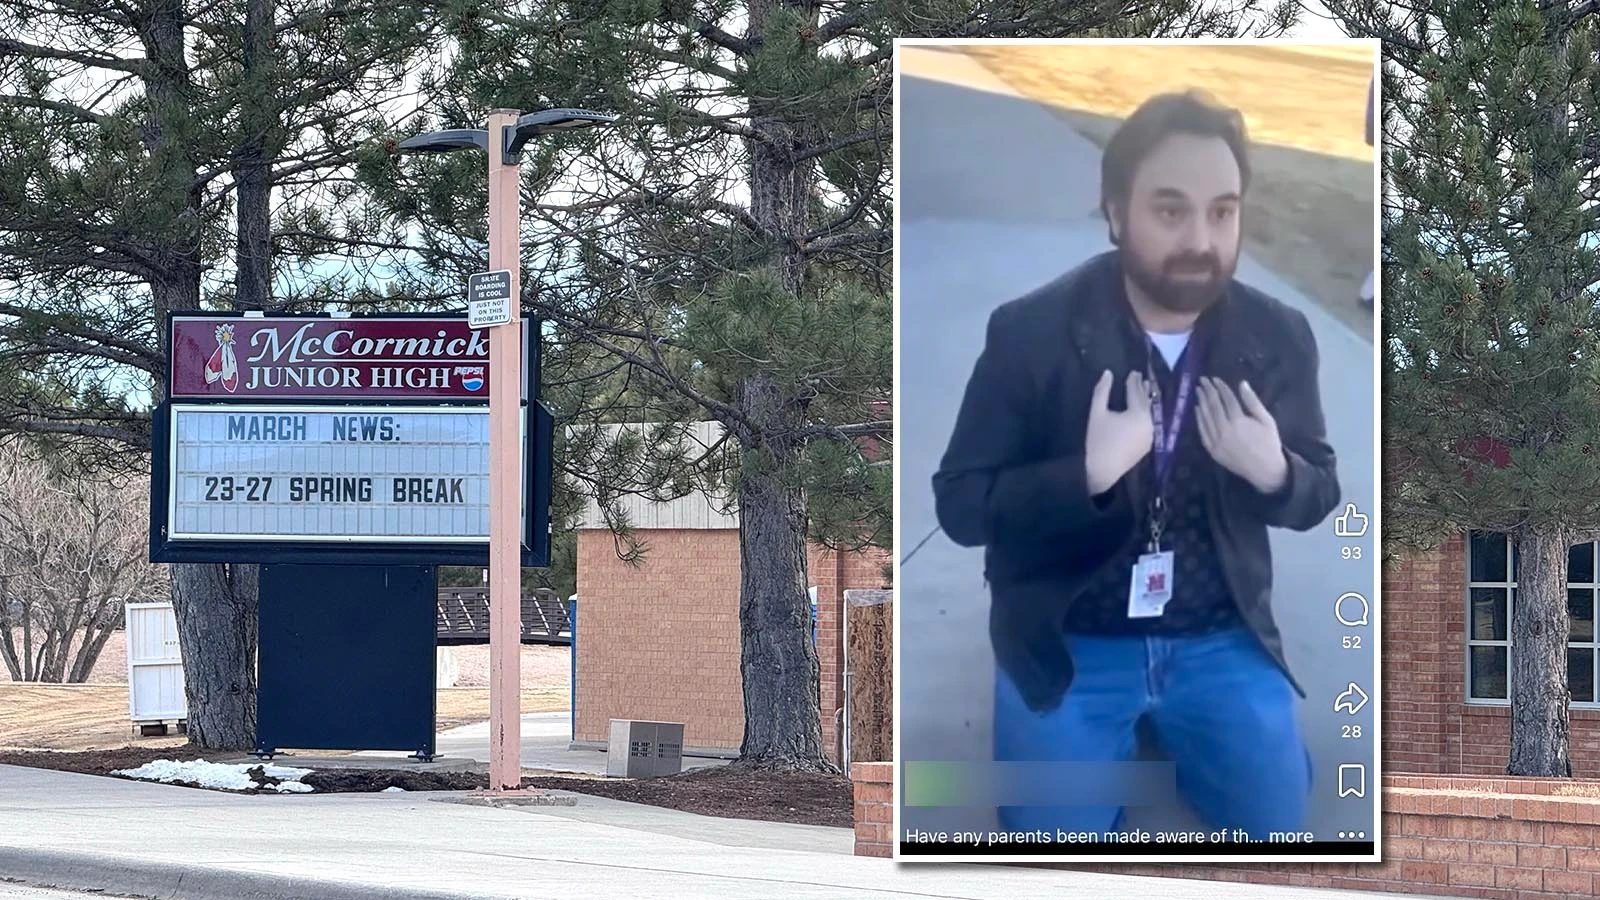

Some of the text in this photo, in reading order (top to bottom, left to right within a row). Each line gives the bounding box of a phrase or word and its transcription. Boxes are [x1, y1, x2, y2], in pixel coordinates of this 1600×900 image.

[475, 282, 505, 290] BOARDING
[247, 323, 489, 363] McCormick
[245, 366, 451, 390] JUNIOR HIGH
[453, 366, 484, 376] PEPSI
[227, 415, 401, 442] MARCH NEWS:
[204, 476, 464, 503] 23-27 SPRING BREAK
